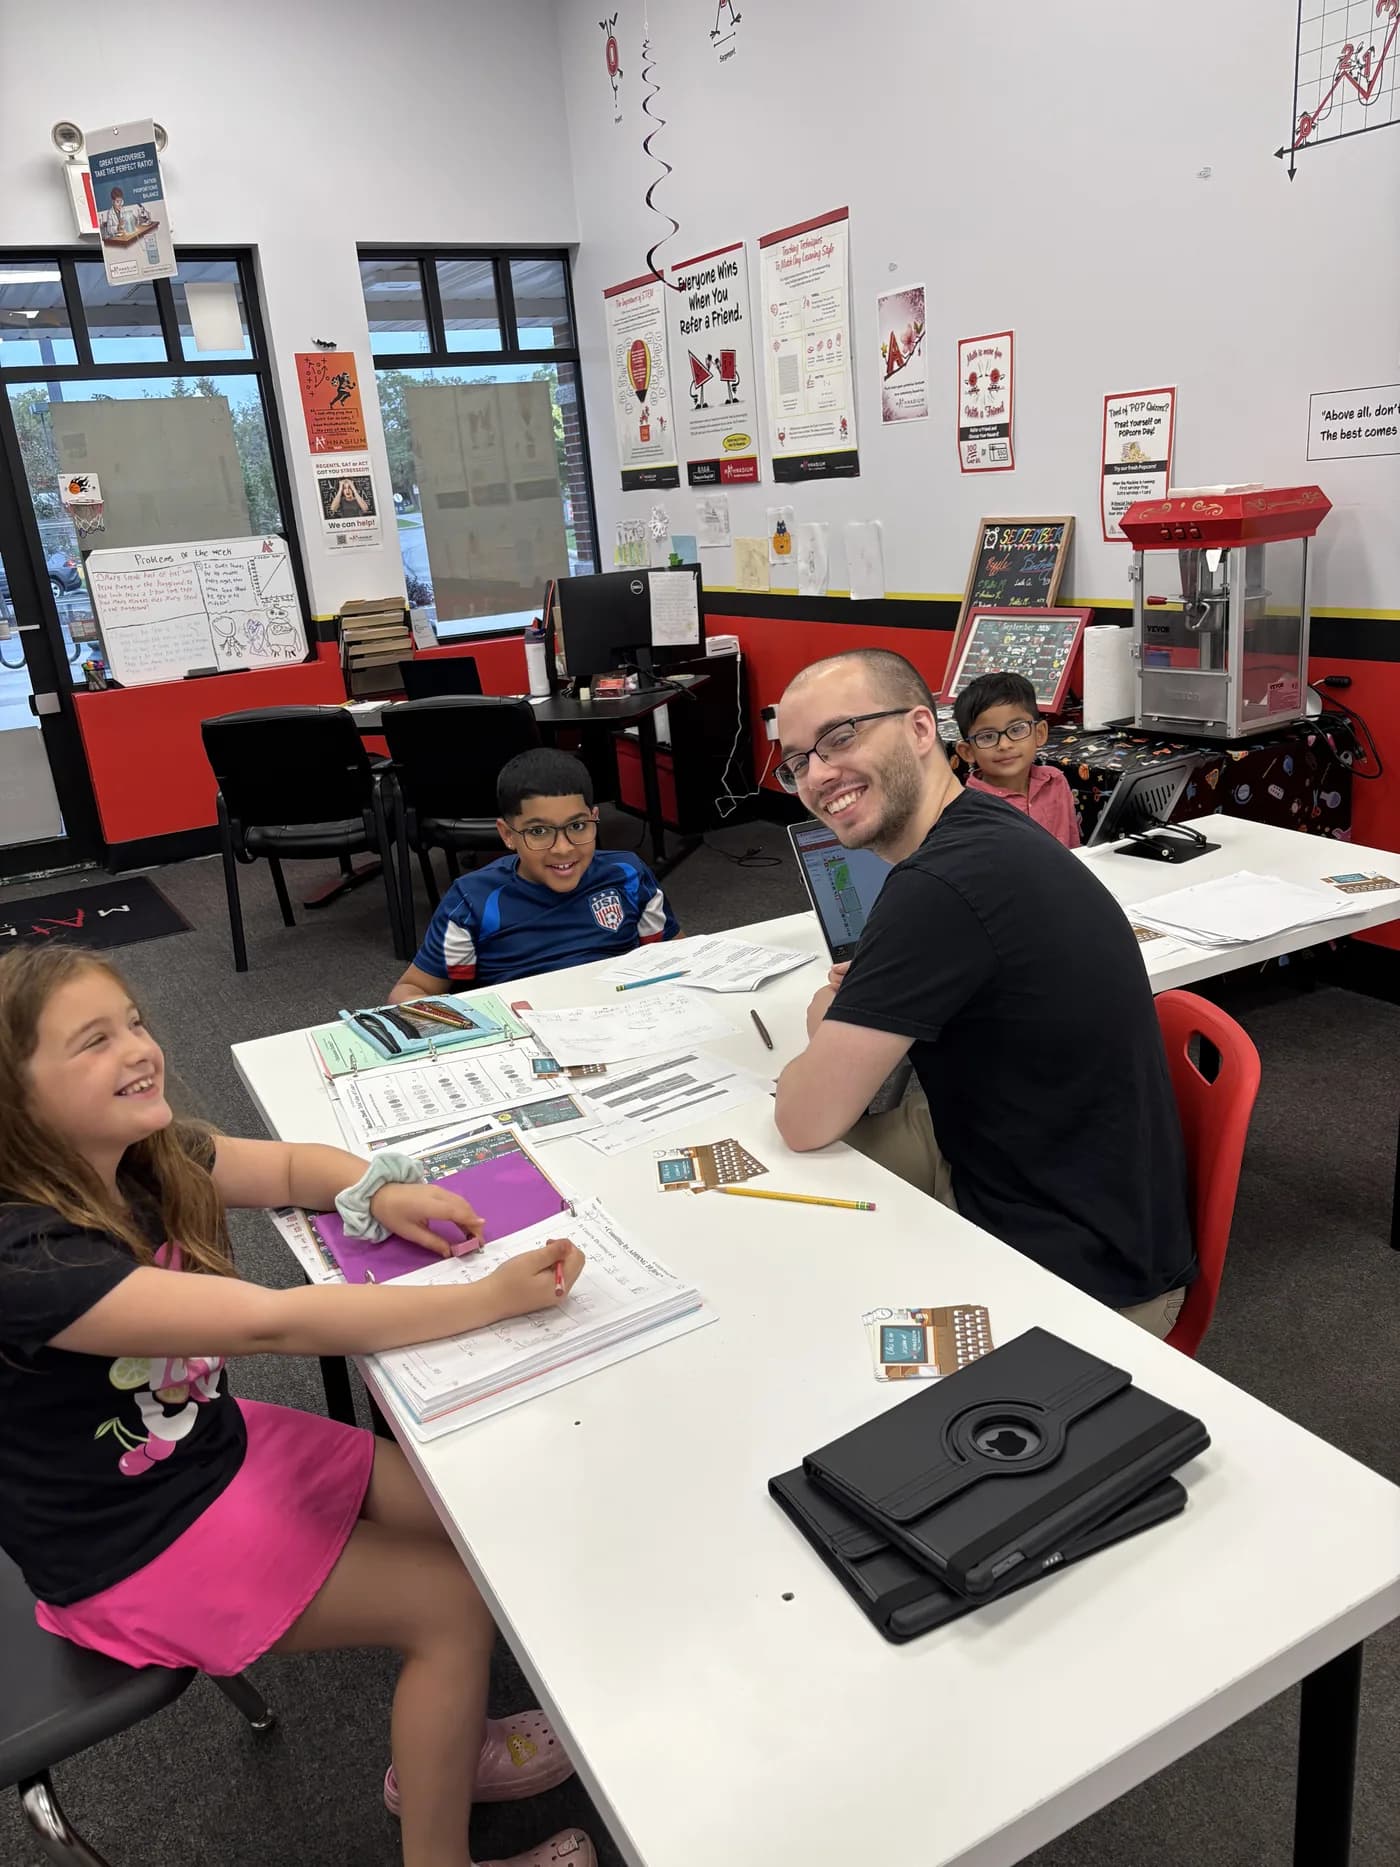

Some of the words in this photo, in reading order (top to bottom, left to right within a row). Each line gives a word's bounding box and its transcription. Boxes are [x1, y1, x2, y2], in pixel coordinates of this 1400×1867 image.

[99, 158, 113, 167] GREAT
[113, 151, 145, 163] DISCOVERIES
[94, 169, 106, 177] TAKE
[116, 163, 137, 173] PERFECT
[717, 260, 738, 280] Wins
[689, 292, 710, 311] When
[712, 288, 728, 305] You
[680, 316, 702, 335] Refer
[705, 315, 710, 329] a
[711, 302, 742, 328] Friend.
[1129, 402, 1145, 412] POP
[1357, 405, 1371, 418] all,
[1114, 420, 1129, 429] Treat
[1130, 417, 1153, 427] Yourself
[1118, 429, 1141, 438] POPcorn
[1142, 426, 1155, 437] Day!
[1320, 429, 1338, 441] The
[1340, 426, 1362, 440] best
[1364, 426, 1398, 438] comes
[357, 519, 376, 527] help!
[1000, 527, 1064, 545] SEPTEMBER
[134, 551, 174, 566] Problems
[1147, 625, 1170, 633] VEVOR
[593, 897, 619, 912] USA
